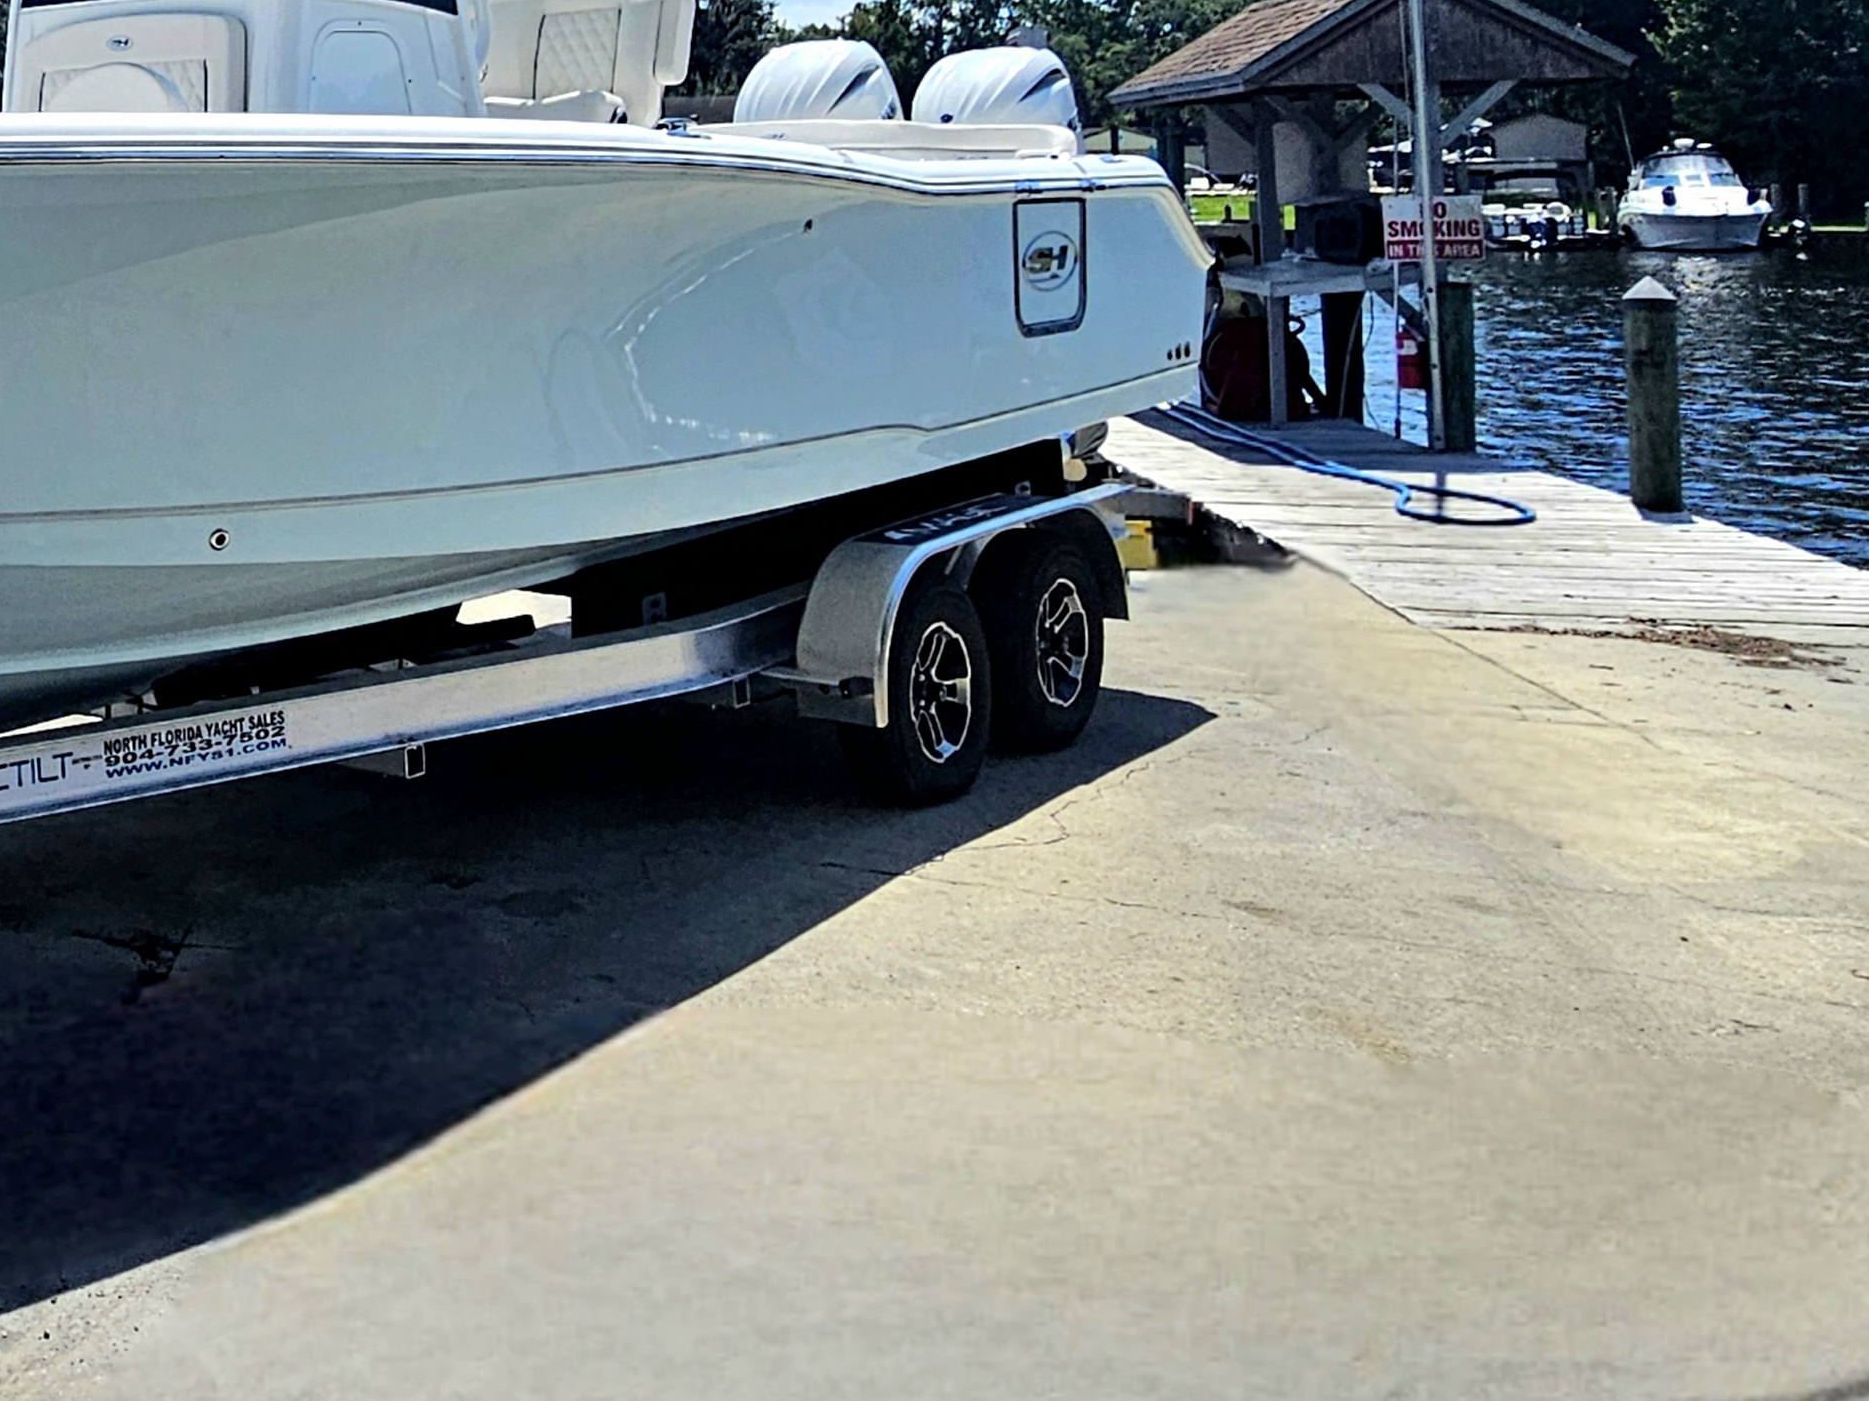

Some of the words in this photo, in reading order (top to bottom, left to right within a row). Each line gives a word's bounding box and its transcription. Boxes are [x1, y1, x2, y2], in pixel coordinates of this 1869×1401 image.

[1419, 202, 1447, 219] O
[104, 735, 148, 756] NORTH
[150, 725, 203, 749] FLORIDA
[205, 717, 247, 737] YACHT
[248, 710, 286, 730] SALES
[104, 725, 286, 767] 904-733-7502
